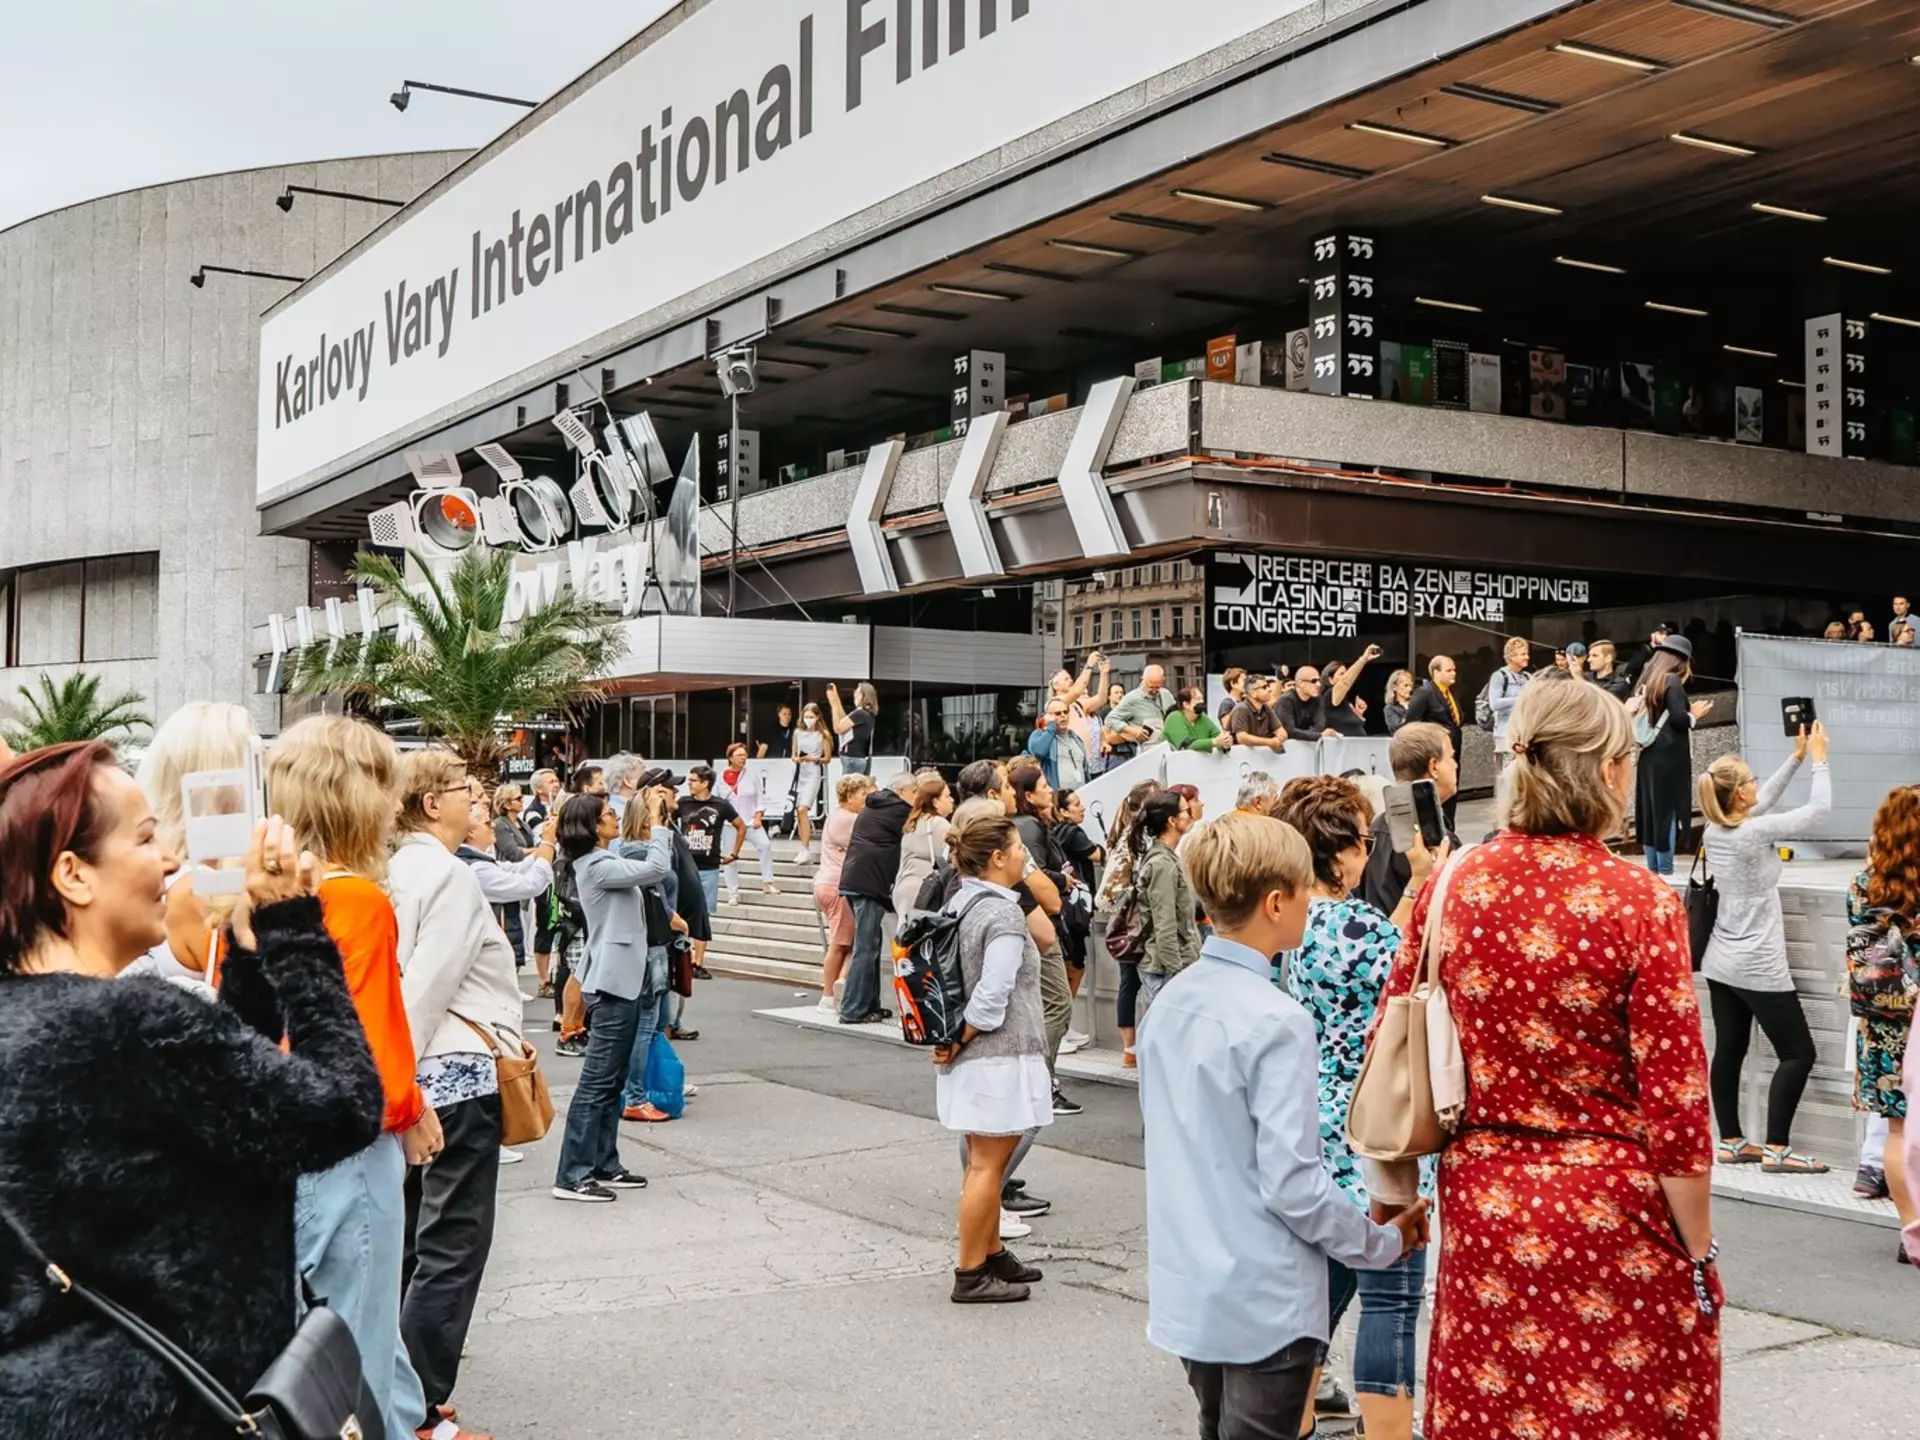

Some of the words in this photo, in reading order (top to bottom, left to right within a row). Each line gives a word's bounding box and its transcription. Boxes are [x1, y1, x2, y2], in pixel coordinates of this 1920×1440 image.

[275, 320, 376, 430] Karlovy
[384, 266, 459, 367] Vary
[471, 13, 814, 321] International
[1258, 555, 1352, 586] RECEPCE
[1474, 572, 1572, 603] SHOPPING
[1214, 604, 1338, 637] CONGRESS
[1258, 582, 1342, 611] CASINO
[1444, 595, 1486, 621] BAR
